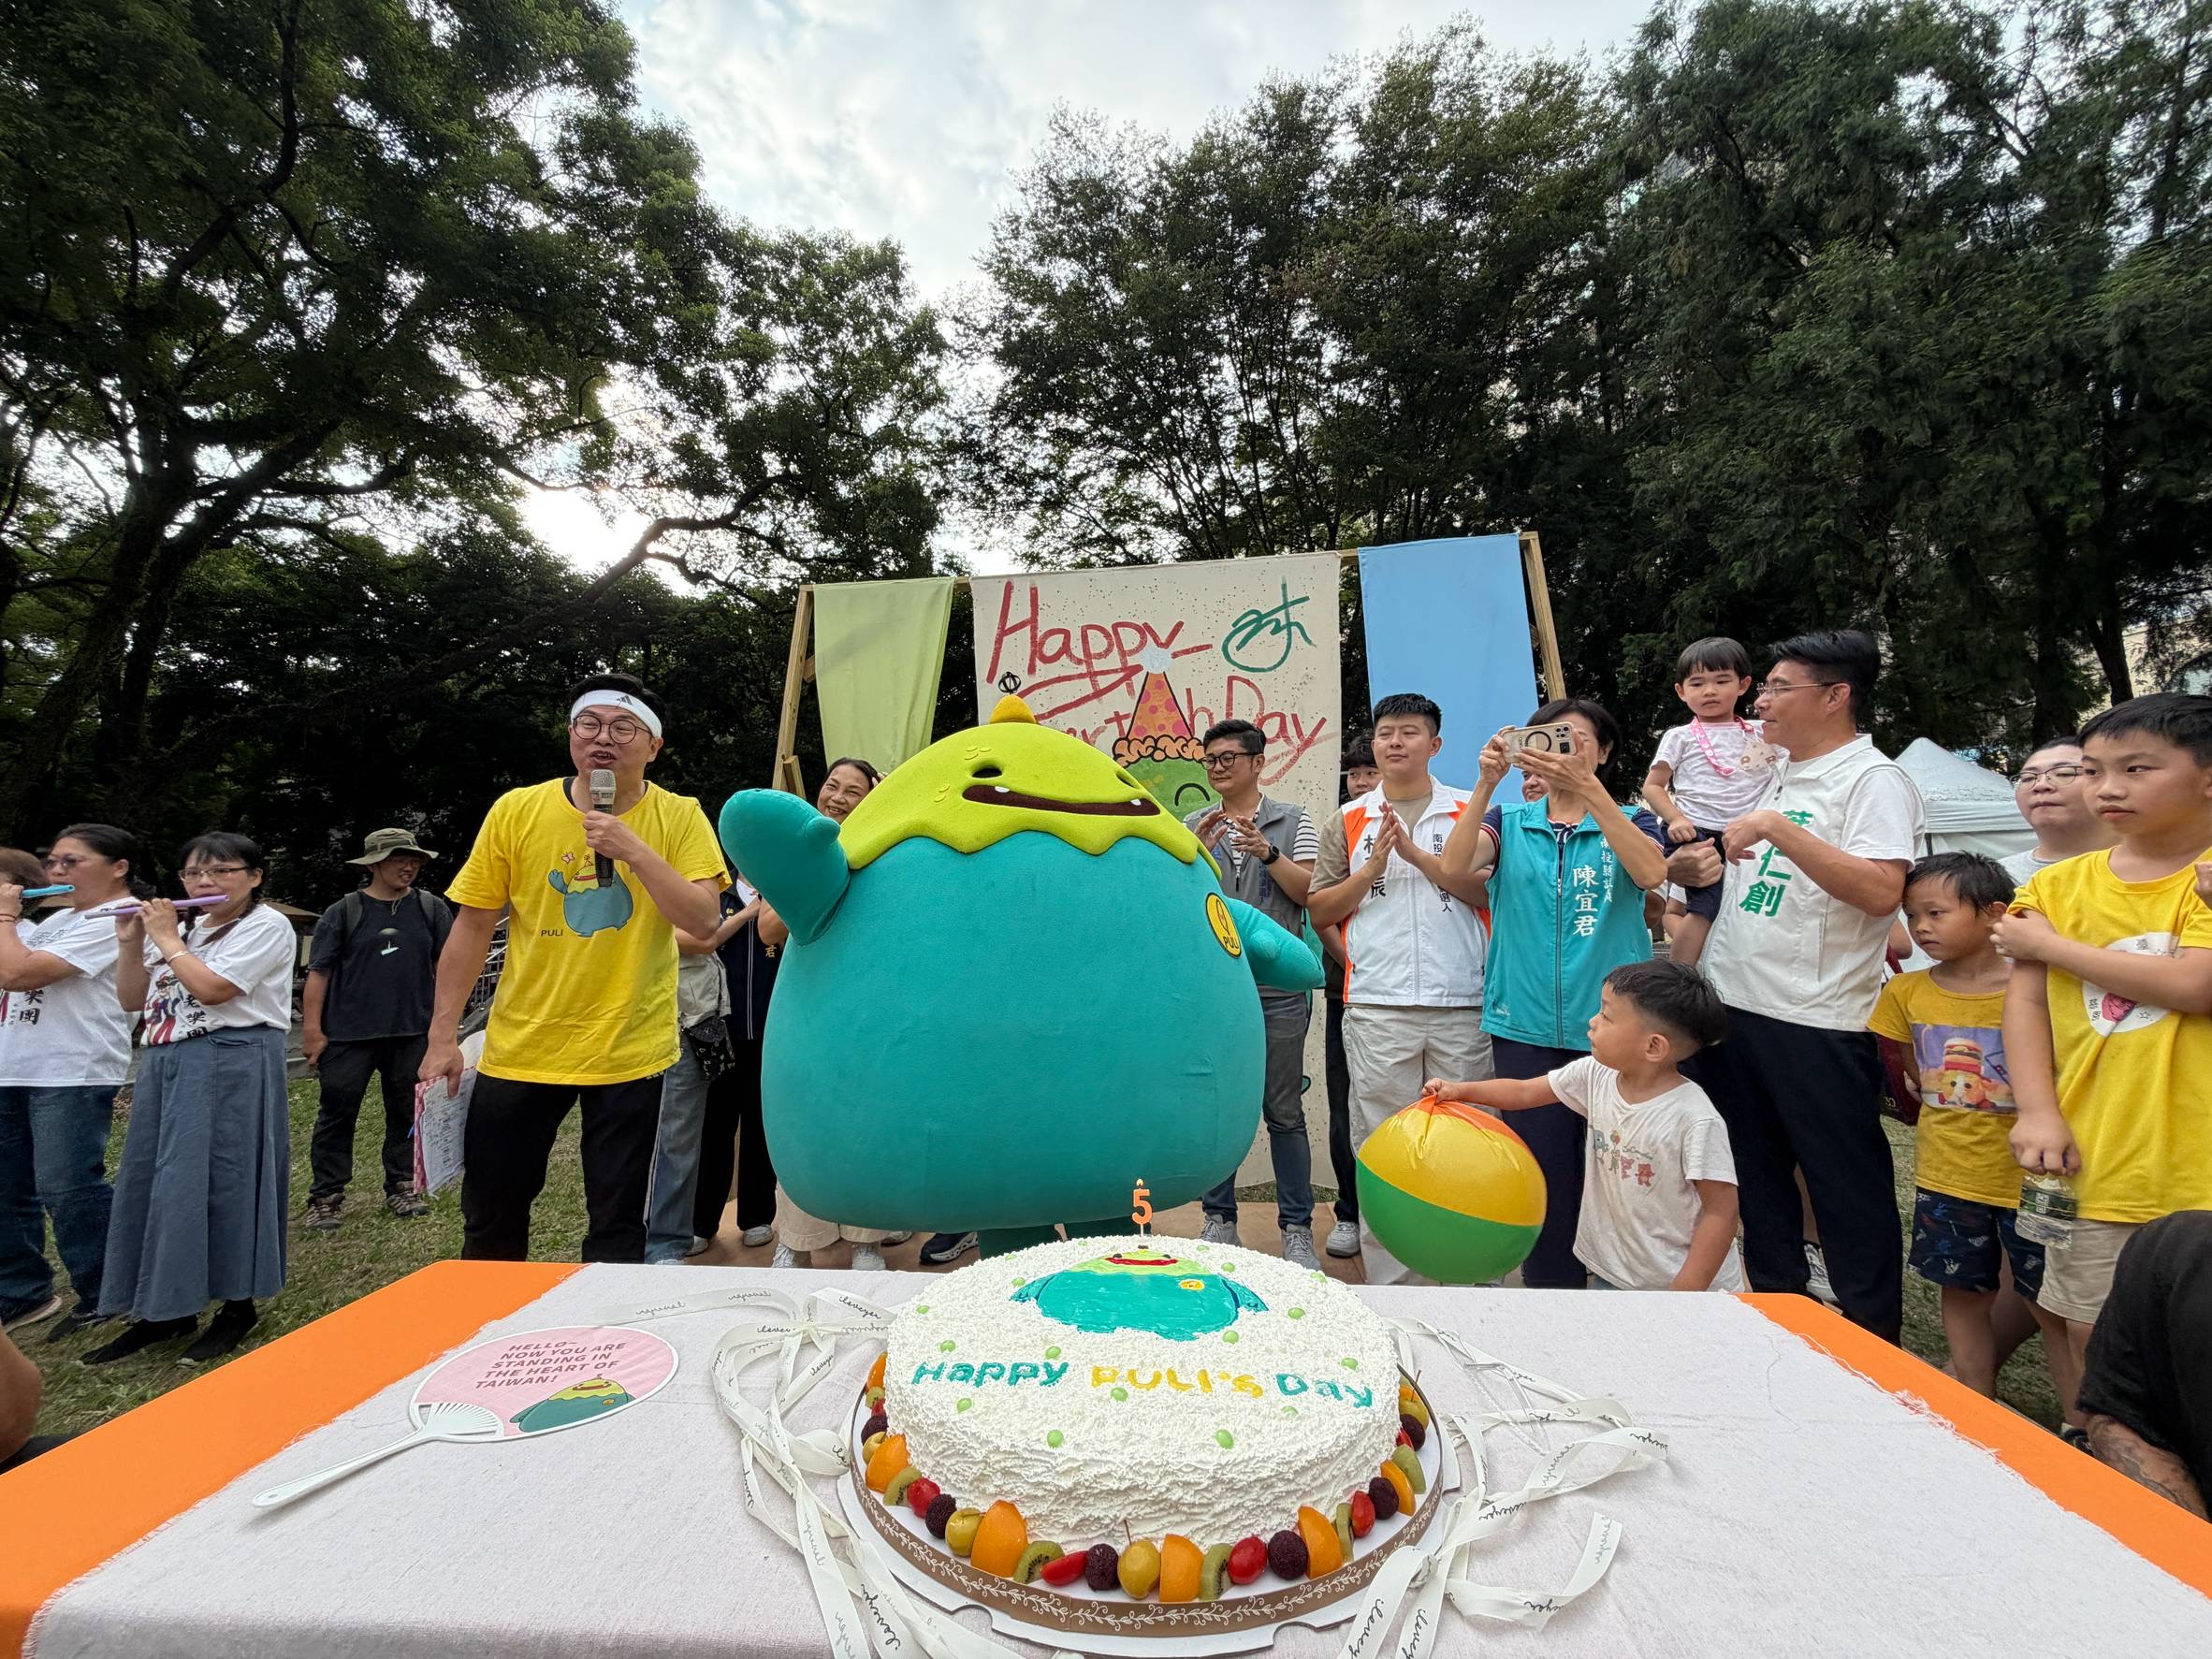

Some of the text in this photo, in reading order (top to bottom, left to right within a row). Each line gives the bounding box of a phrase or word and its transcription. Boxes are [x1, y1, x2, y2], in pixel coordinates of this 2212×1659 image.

[986, 580, 1213, 702] Happy
[1572, 864, 1600, 938] 陳宜君
[541, 928, 564, 937] PULI
[1131, 1188, 1153, 1225] 5
[491, 1352, 612, 1369] STANDING IN
[501, 1342, 628, 1360] NOW YOU ARE
[485, 1360, 620, 1379] THE HEART OF
[474, 1375, 559, 1390] TAIWAN!
[910, 1361, 1070, 1389] Happy
[1275, 1372, 1374, 1408] Day
